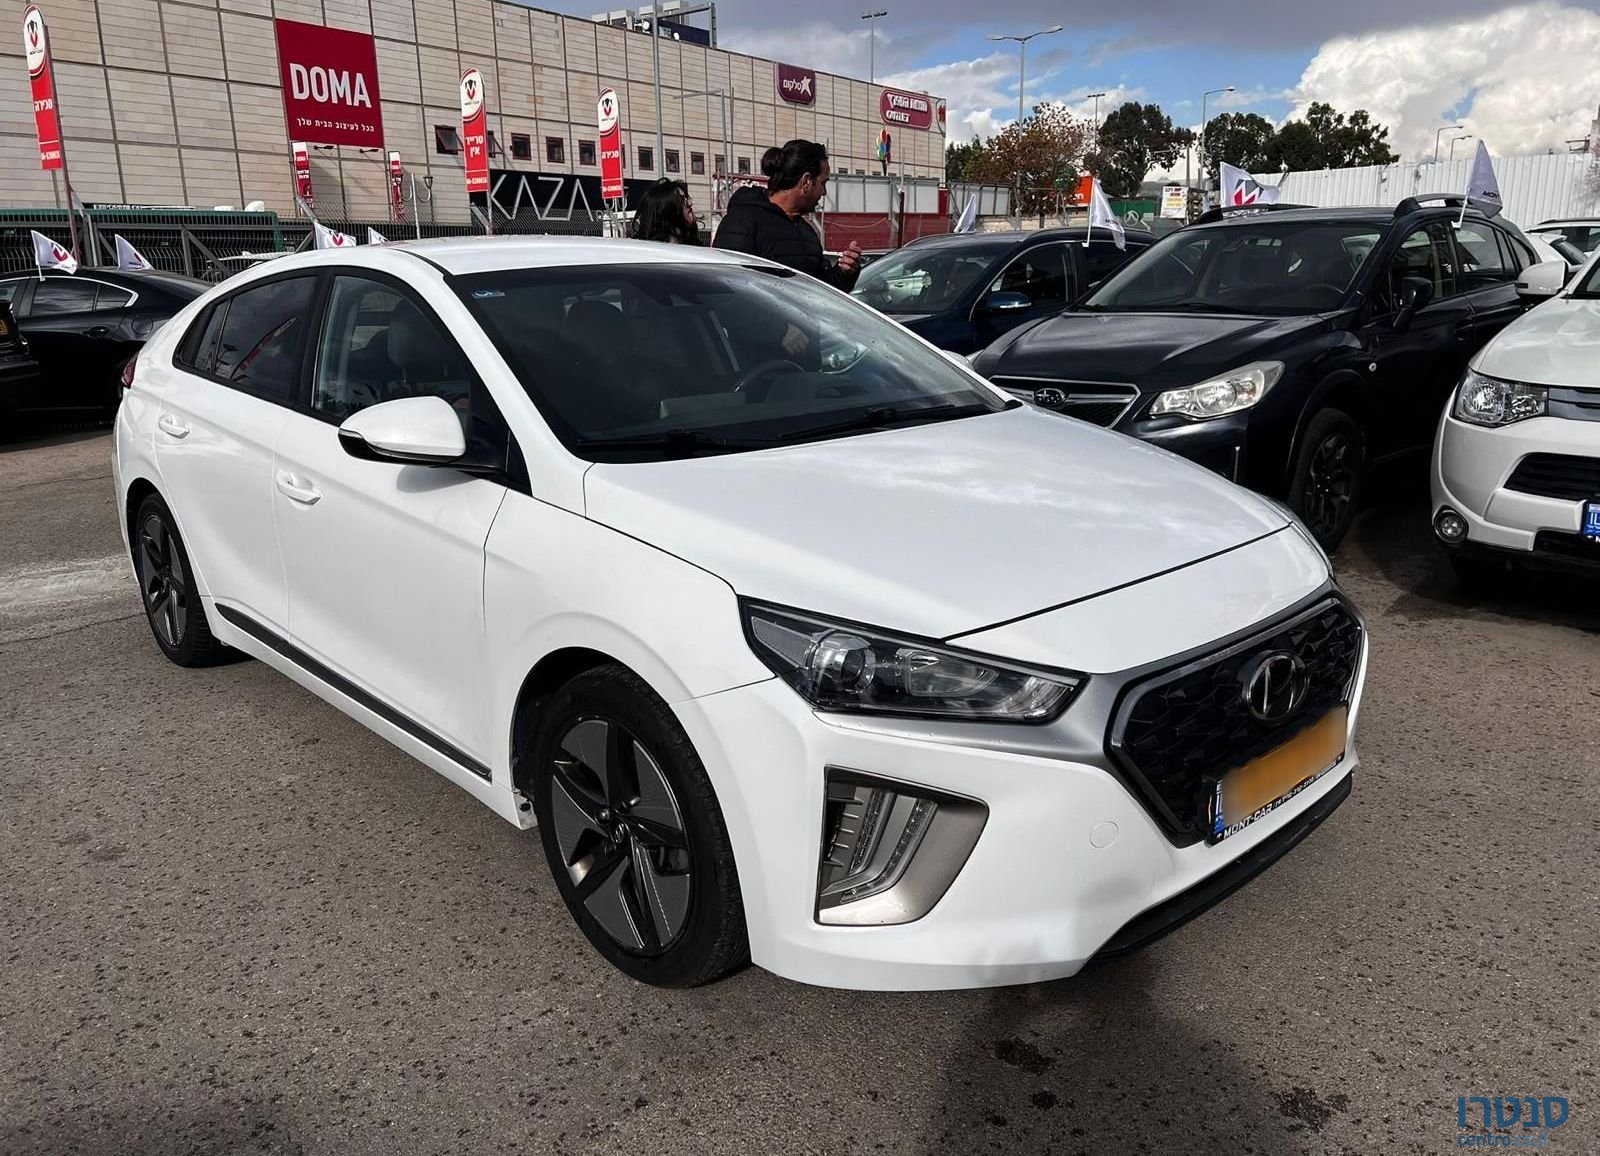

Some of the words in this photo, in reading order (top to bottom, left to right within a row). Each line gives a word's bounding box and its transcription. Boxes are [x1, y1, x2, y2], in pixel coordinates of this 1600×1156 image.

[289, 62, 373, 109] DOMA
[783, 78, 802, 92] סלקום
[296, 116, 313, 127] שלך
[314, 118, 333, 128] הבית
[335, 121, 359, 131] לעיצוב
[361, 122, 375, 133] הכל
[470, 146, 481, 158] אין
[489, 173, 595, 223] KAZA
[1223, 803, 1273, 839] MONT-CAR
